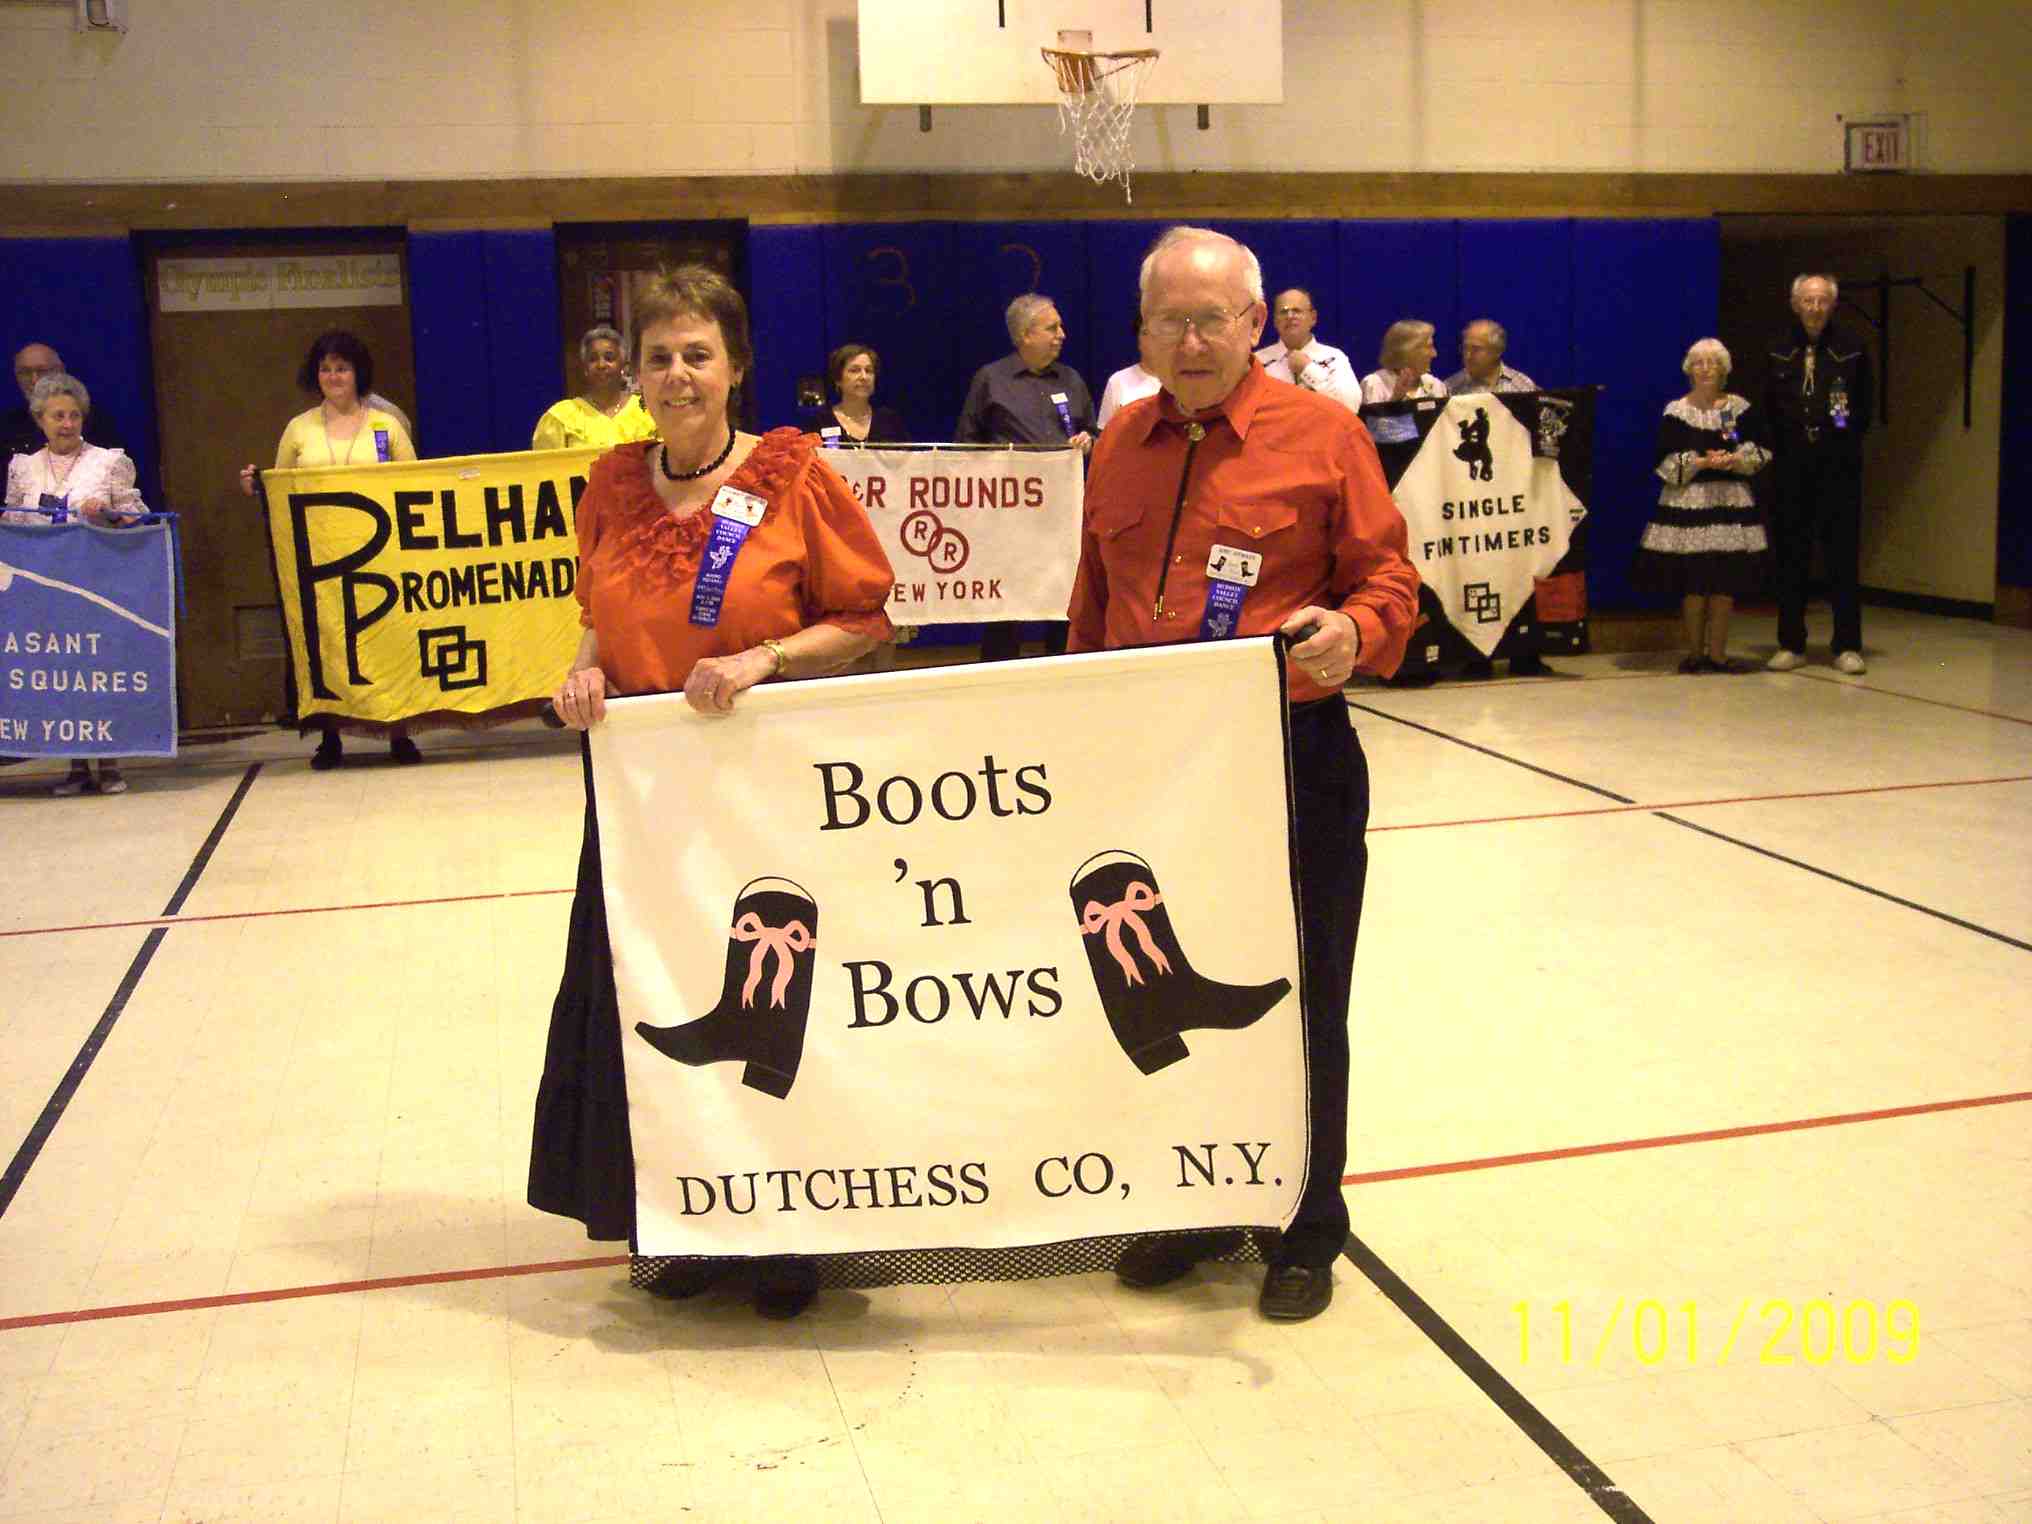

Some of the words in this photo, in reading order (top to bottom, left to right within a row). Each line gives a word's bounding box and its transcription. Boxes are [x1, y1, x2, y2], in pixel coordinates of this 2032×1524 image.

[1864, 131, 1899, 163] EXIT
[840, 475, 886, 508] &R
[909, 476, 1044, 509] ROUNDS
[1441, 494, 1526, 520] SINGLE
[913, 520, 928, 541] R
[943, 541, 957, 562] R
[936, 579, 1002, 601] YORK
[4, 631, 101, 655] ASANT
[9, 668, 148, 693] SQUARES
[41, 719, 113, 742] YORK
[813, 754, 1052, 831] Boots
[841, 960, 1063, 1029] Bows
[676, 1162, 990, 1216] DUTCHESS
[1034, 1152, 1131, 1200] CO,
[1171, 1142, 1283, 1188] N.Y.
